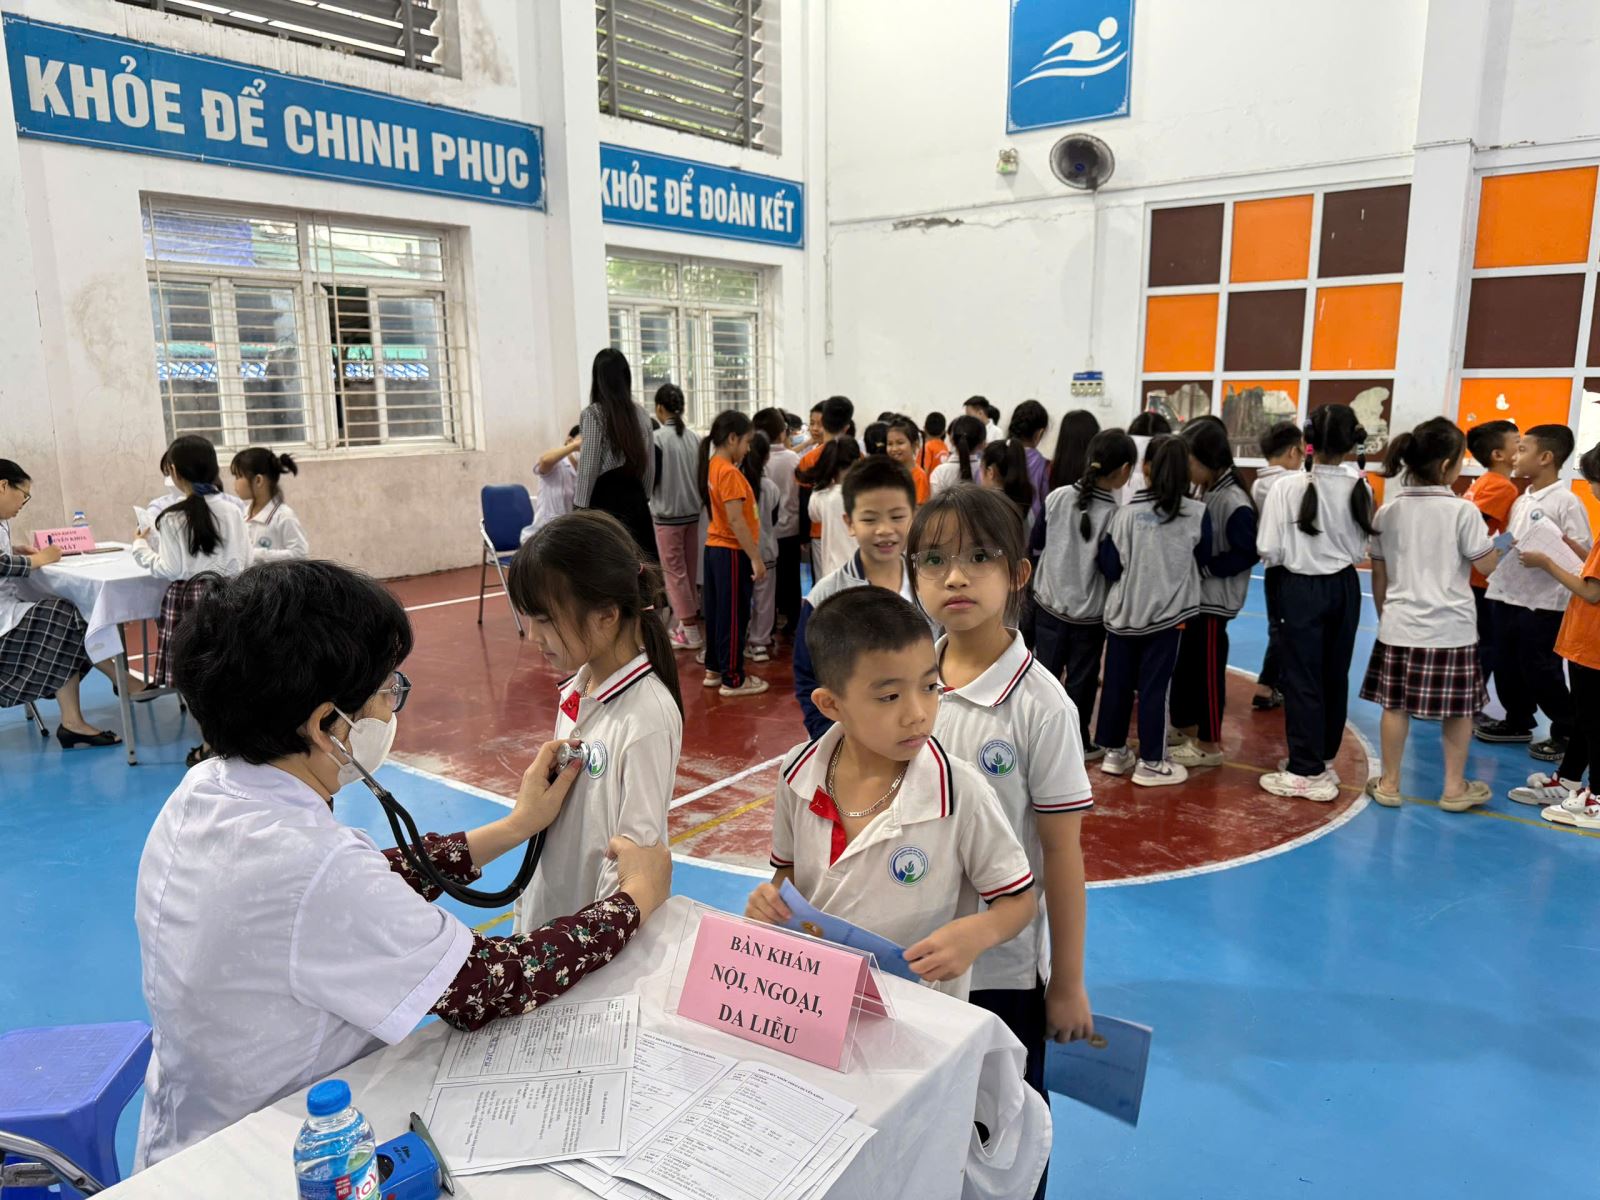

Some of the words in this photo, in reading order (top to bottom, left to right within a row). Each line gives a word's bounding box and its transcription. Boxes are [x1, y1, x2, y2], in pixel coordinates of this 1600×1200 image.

[24, 55, 185, 135] KHỎE
[201, 78, 268, 148] ĐỂ
[283, 105, 420, 172] CHINH
[431, 132, 530, 194] PHỤC
[601, 160, 658, 213] KHỎE
[664, 168, 694, 218] ĐỂ
[699, 183, 756, 227] ĐOÀN
[761, 189, 795, 233] KẾT
[730, 936, 765, 958] BÀN
[767, 946, 821, 976] KHÁM
[709, 963, 748, 993] NỘI,
[753, 976, 823, 1018] NGOẠI,
[718, 1003, 743, 1028] DA
[750, 1013, 798, 1044] LIỄU
